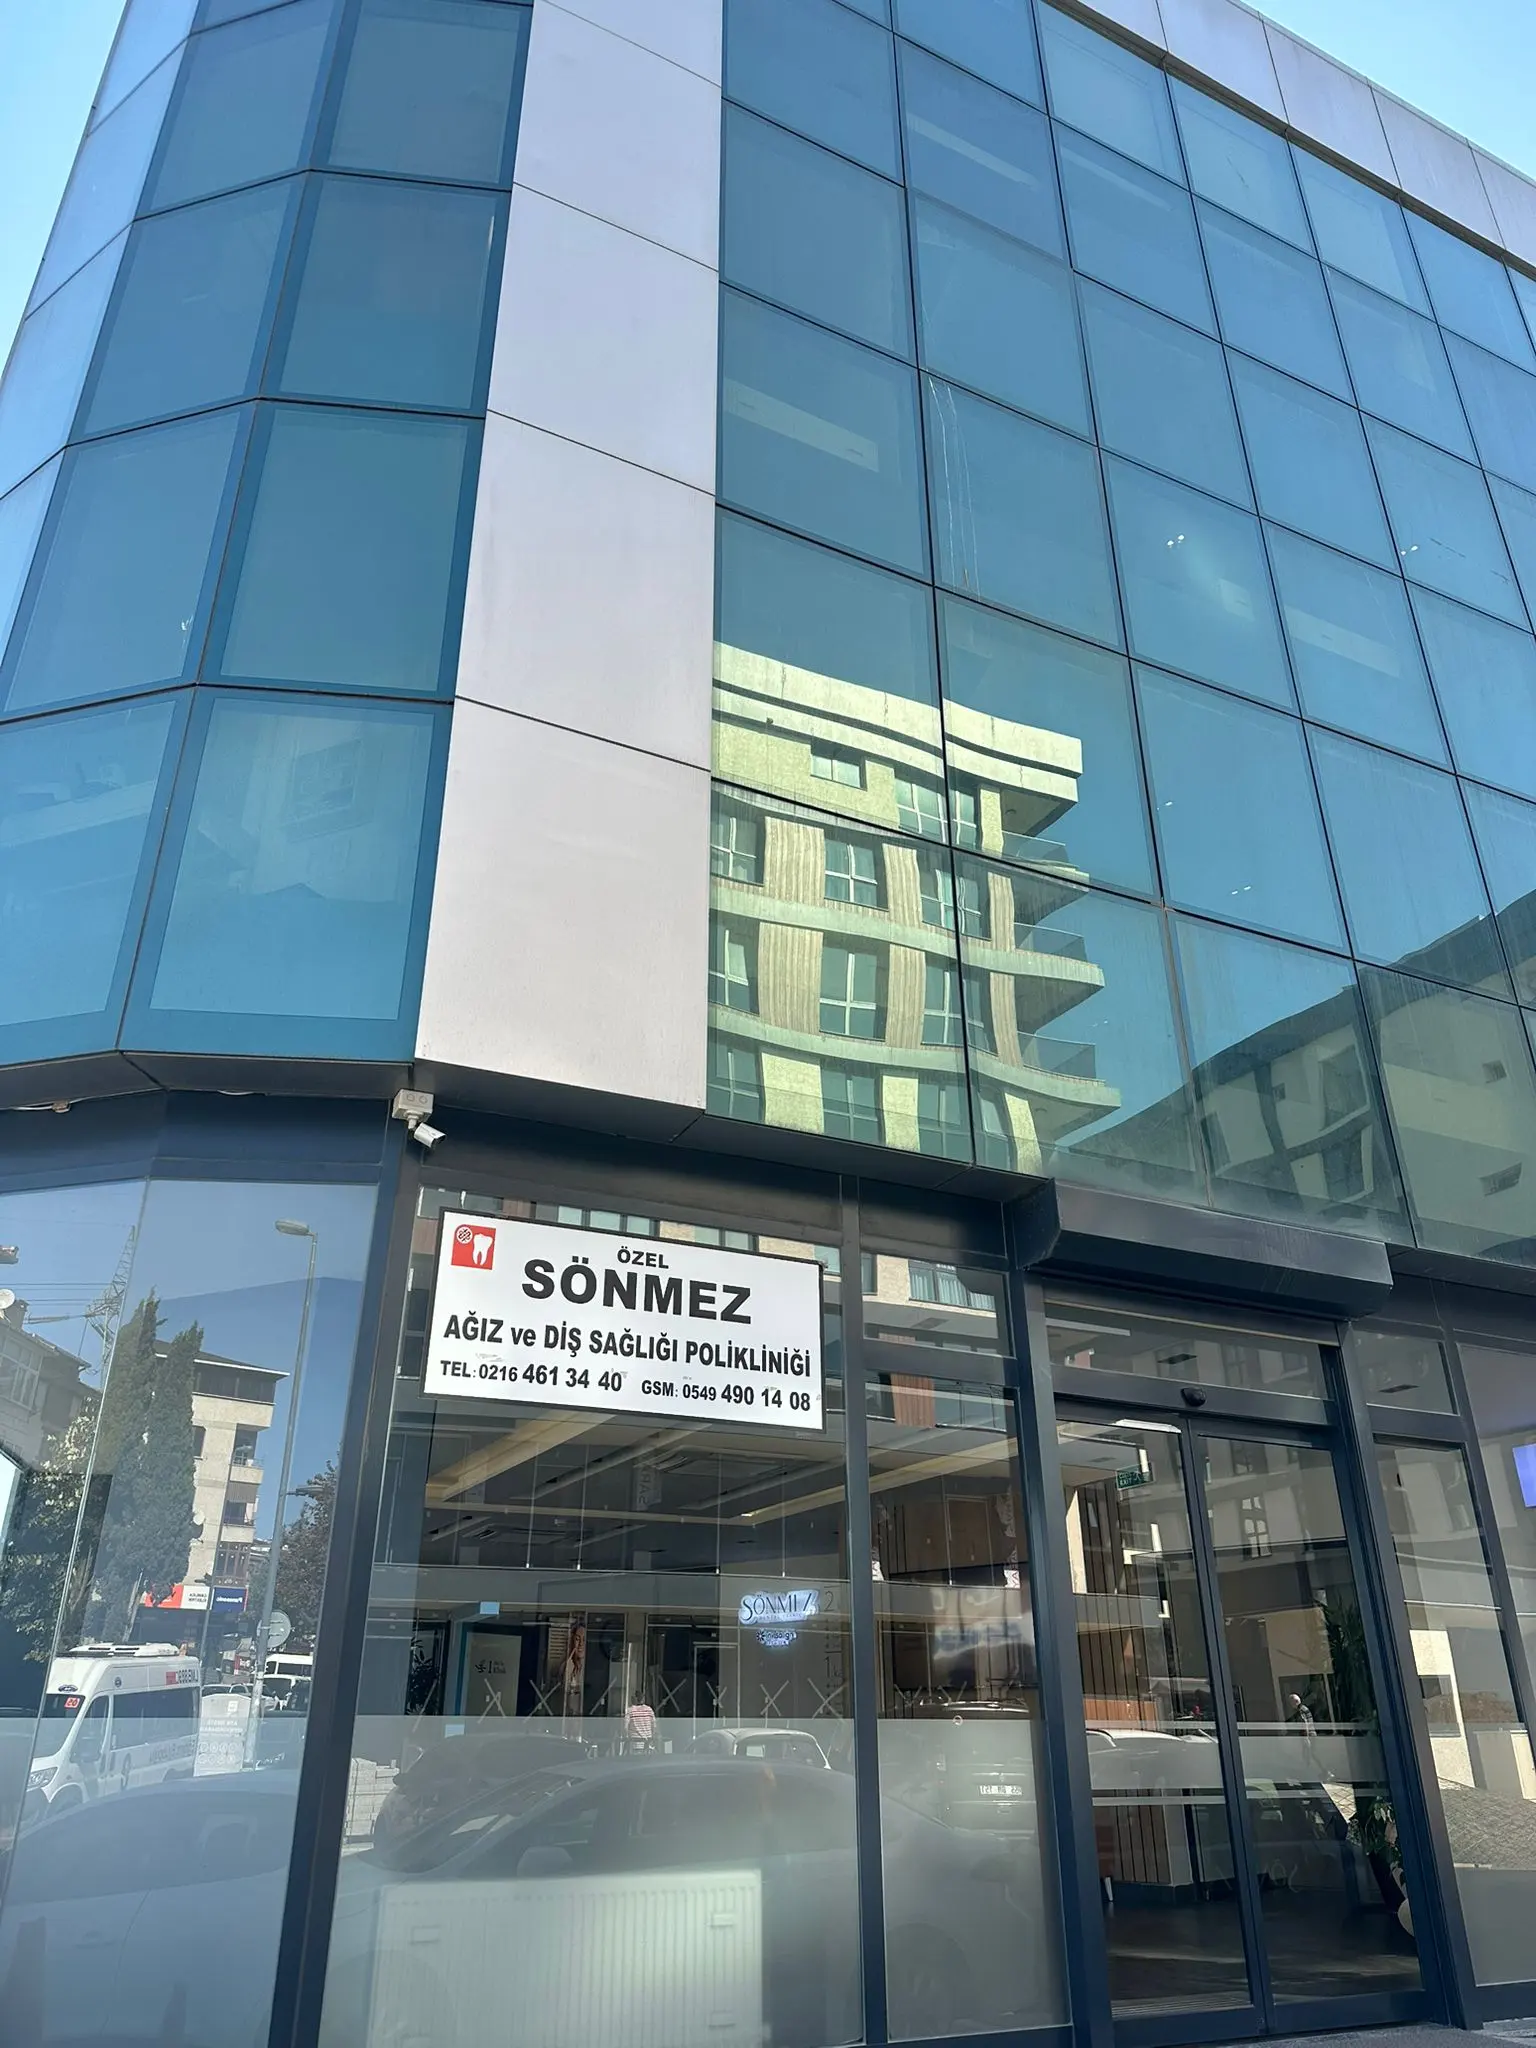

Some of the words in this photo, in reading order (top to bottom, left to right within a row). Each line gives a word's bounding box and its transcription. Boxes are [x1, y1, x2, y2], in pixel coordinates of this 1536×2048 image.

[617, 1245, 669, 1270] ÖZEL
[521, 1255, 752, 1325] SÖNMEZ
[443, 1310, 504, 1344] AĞIZ
[510, 1327, 537, 1347] ve
[543, 1320, 582, 1358] DİŞ
[588, 1327, 678, 1362] SAĞLIĞI
[685, 1340, 811, 1378] POLİKLİNİĞİ
[522, 1363, 559, 1386] 461
[565, 1367, 590, 1388] 34
[597, 1371, 622, 1392] 40
[682, 1383, 717, 1402] 0549
[720, 1383, 755, 1407] 490
[761, 1388, 783, 1409] 14
[789, 1391, 811, 1412] 08
